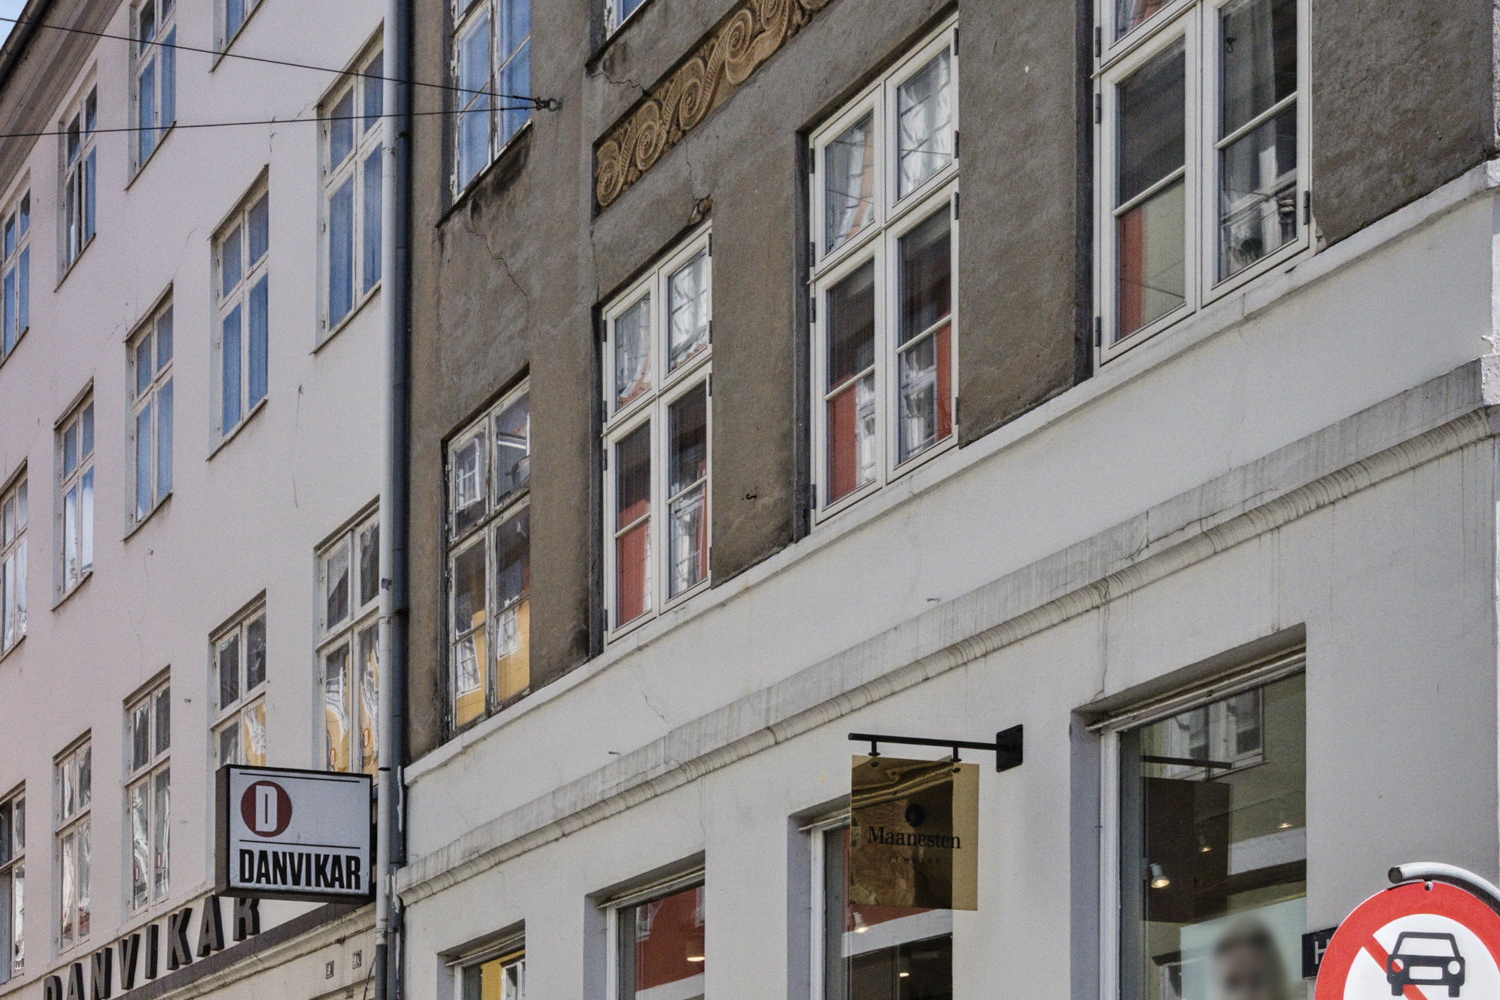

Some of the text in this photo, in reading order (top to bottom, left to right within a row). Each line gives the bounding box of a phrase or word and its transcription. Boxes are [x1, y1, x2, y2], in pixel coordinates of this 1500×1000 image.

[255, 785, 278, 832] D
[867, 826, 962, 849] Maanesten
[239, 849, 361, 890] DANVIKAR
